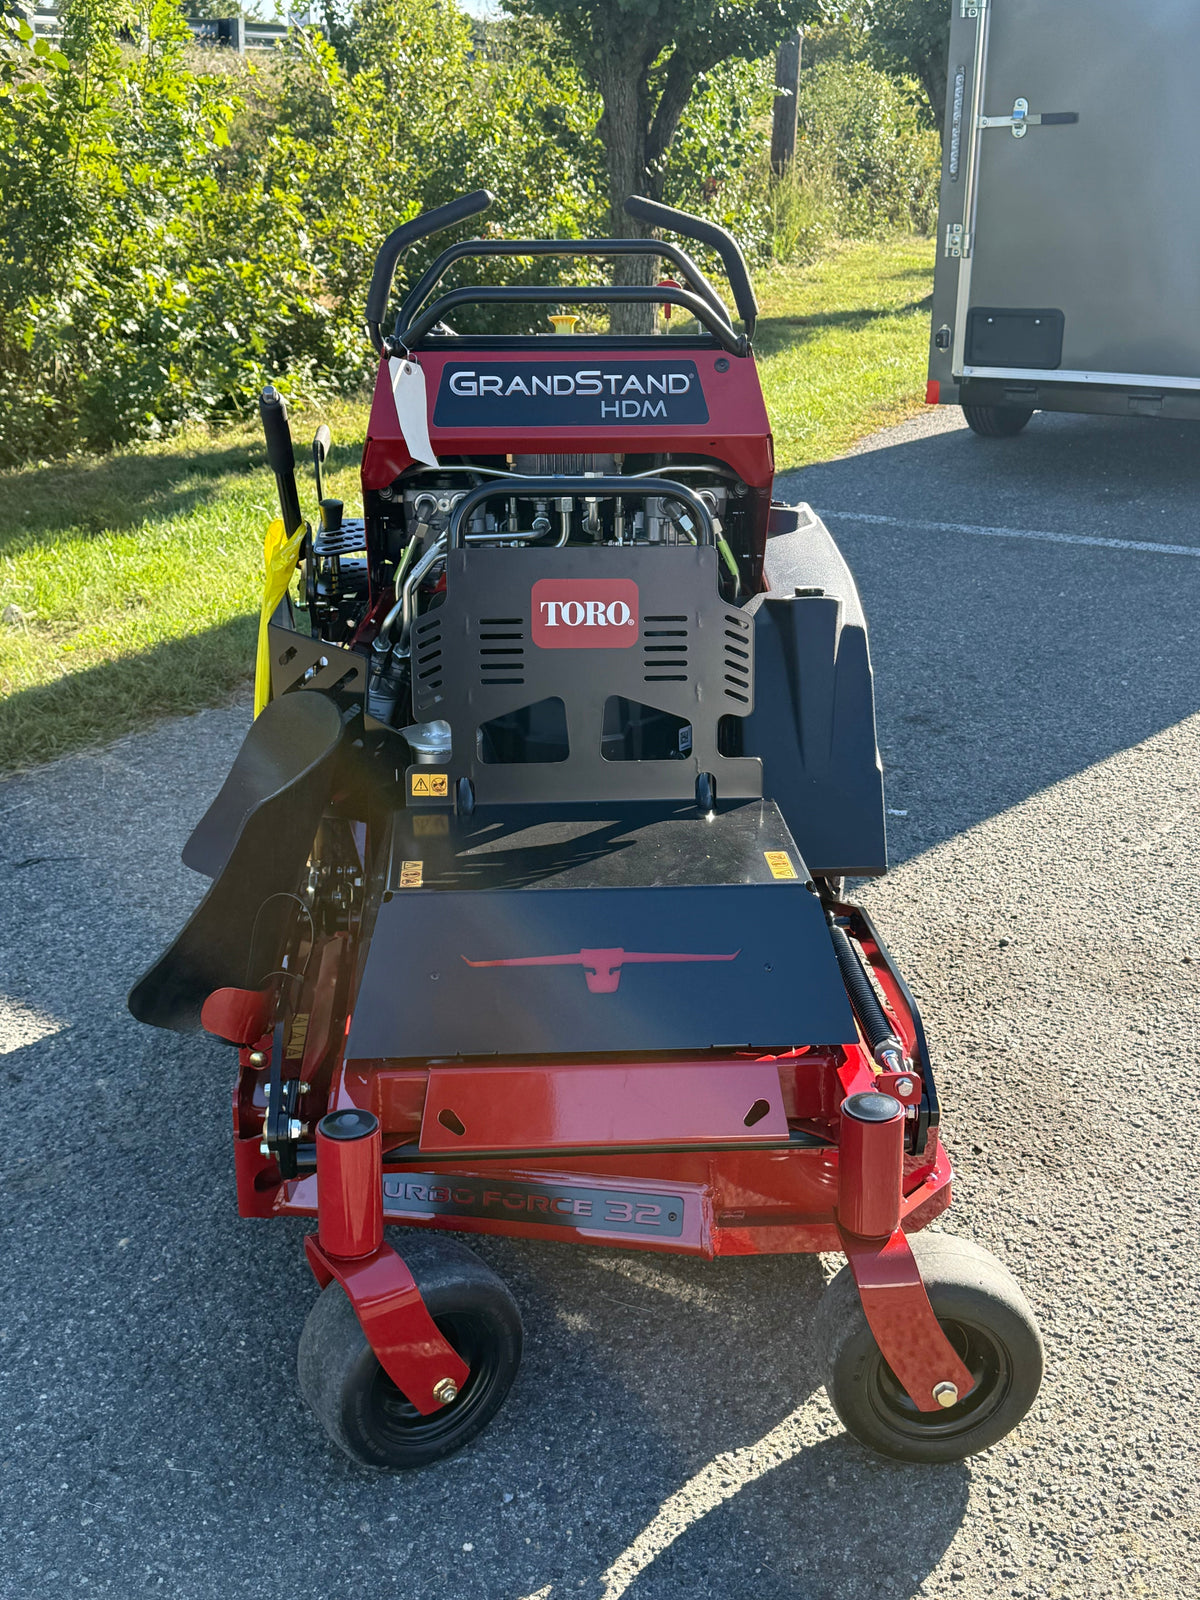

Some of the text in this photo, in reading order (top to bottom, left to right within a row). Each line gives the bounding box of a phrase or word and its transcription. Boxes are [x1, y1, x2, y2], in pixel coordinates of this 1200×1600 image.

[601, 400, 668, 418] HDM
[540, 600, 632, 626] TORO
[383, 1181, 662, 1225] URBO FORCE 32
